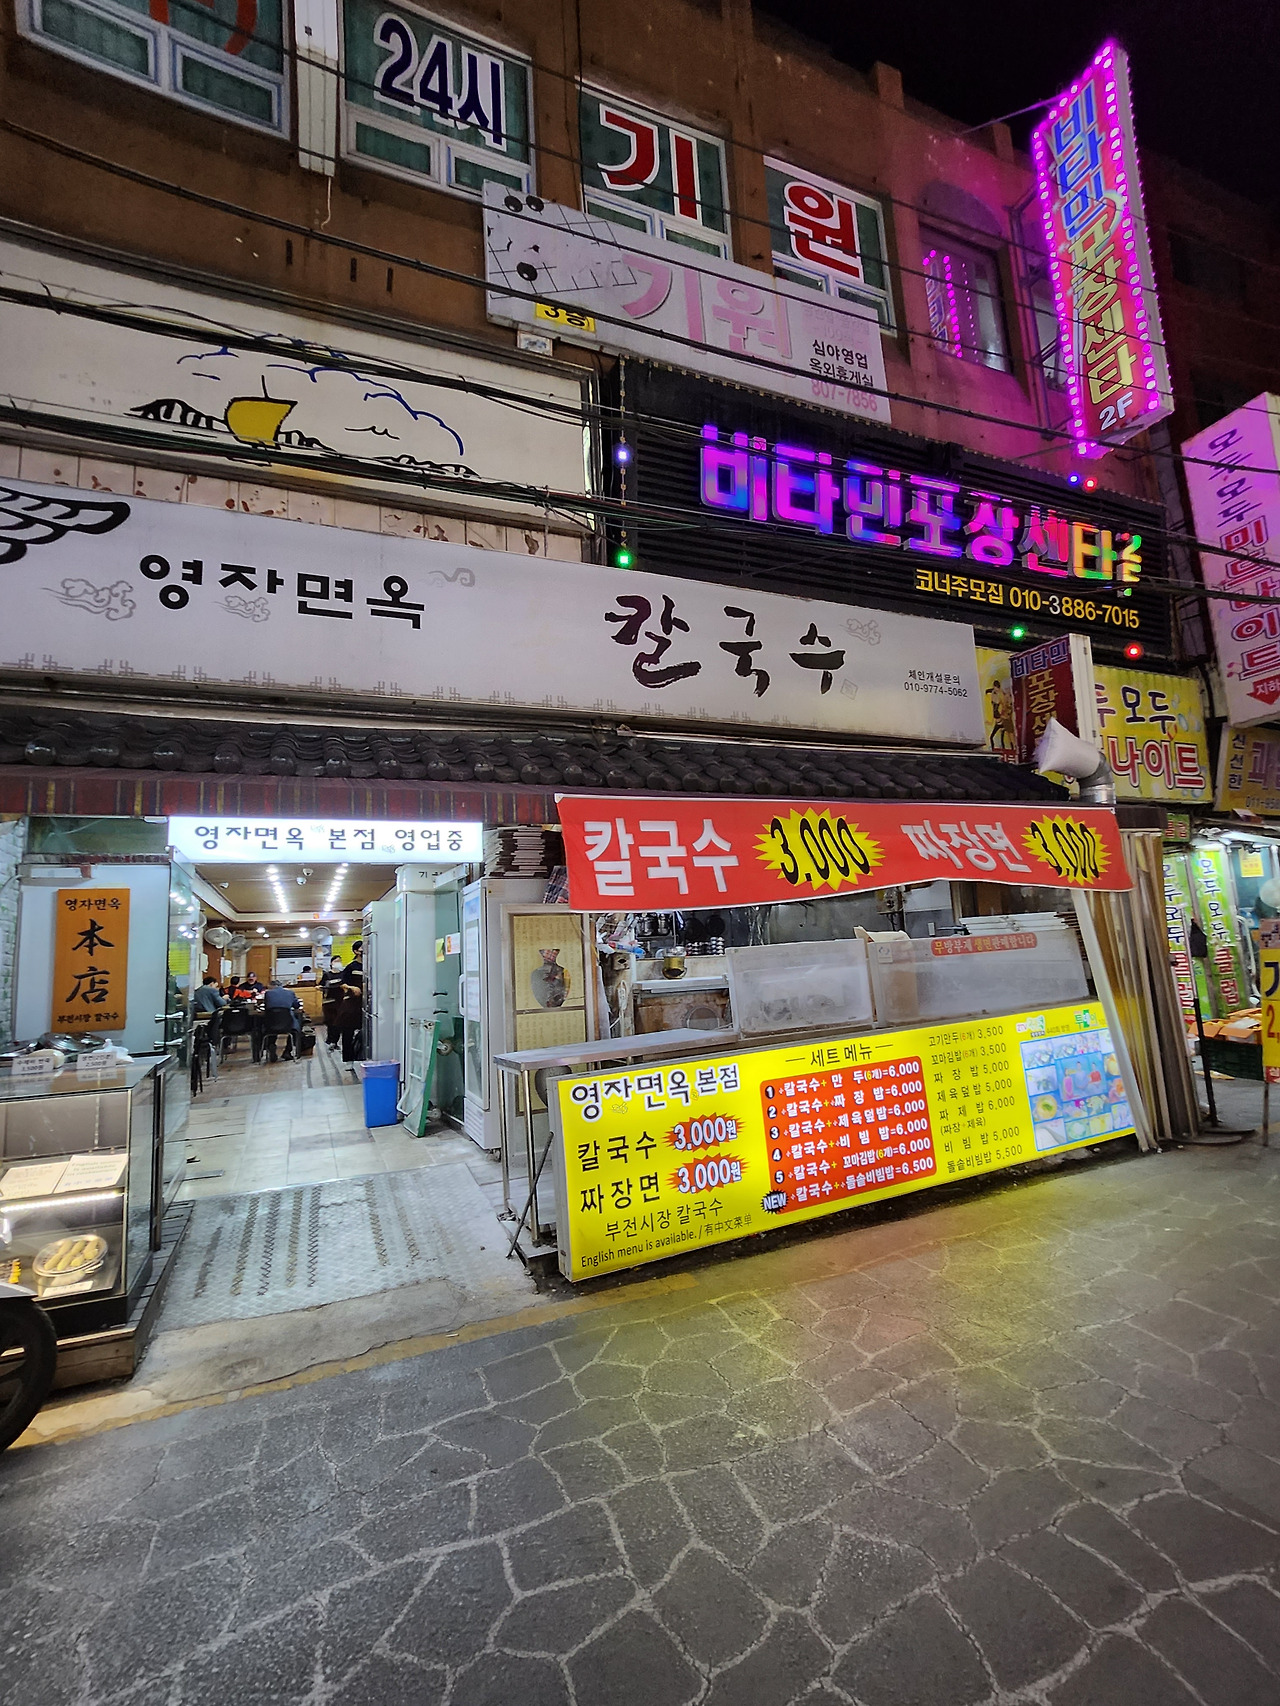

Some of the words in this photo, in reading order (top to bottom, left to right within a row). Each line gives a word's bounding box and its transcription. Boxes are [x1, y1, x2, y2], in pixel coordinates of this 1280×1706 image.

[376, 16, 503, 149] 24시
[620, 254, 793, 376] 기원
[809, 358, 873, 387] 옥외휴게실
[813, 340, 868, 369] 심야영업
[811, 379, 877, 411] 807-7856
[1099, 392, 1133, 431] 2F
[139, 554, 425, 630] 영자면옥
[915, 568, 1003, 605] 코너주모집
[1010, 587, 1140, 629] 010-3886-7015
[604, 594, 847, 697] 칼국수
[1013, 642, 1068, 678] 비타민
[904, 682, 968, 698] 010-9774-5062
[908, 668, 961, 686] 체인개설문의
[1028, 669, 1059, 736] 포장센
[1229, 733, 1246, 790] 신선한
[195, 826, 304, 850] 영자면옥
[328, 828, 375, 850] 본점
[395, 829, 463, 851] 영업중
[584, 818, 739, 896] 칼국수
[901, 819, 1032, 873] 짜장면
[65, 897, 121, 911] 영자면옥
[65, 918, 115, 1004] 本店
[810, 1049, 840, 1067] 세트
[844, 1043, 872, 1061] 메뉴
[572, 1070, 690, 1121] 영자면옥
[697, 1064, 740, 1093] 본점
[578, 1131, 658, 1173] 칼국수
[580, 1172, 661, 1214] 짜장면
[763, 1193, 787, 1210] NEW
[605, 1209, 671, 1242] 부전시장
[677, 1198, 724, 1225] 칼국수
[581, 1249, 615, 1268] English
[617, 1242, 644, 1257] menu
[645, 1238, 654, 1250] is
[655, 1229, 698, 1248] available.
